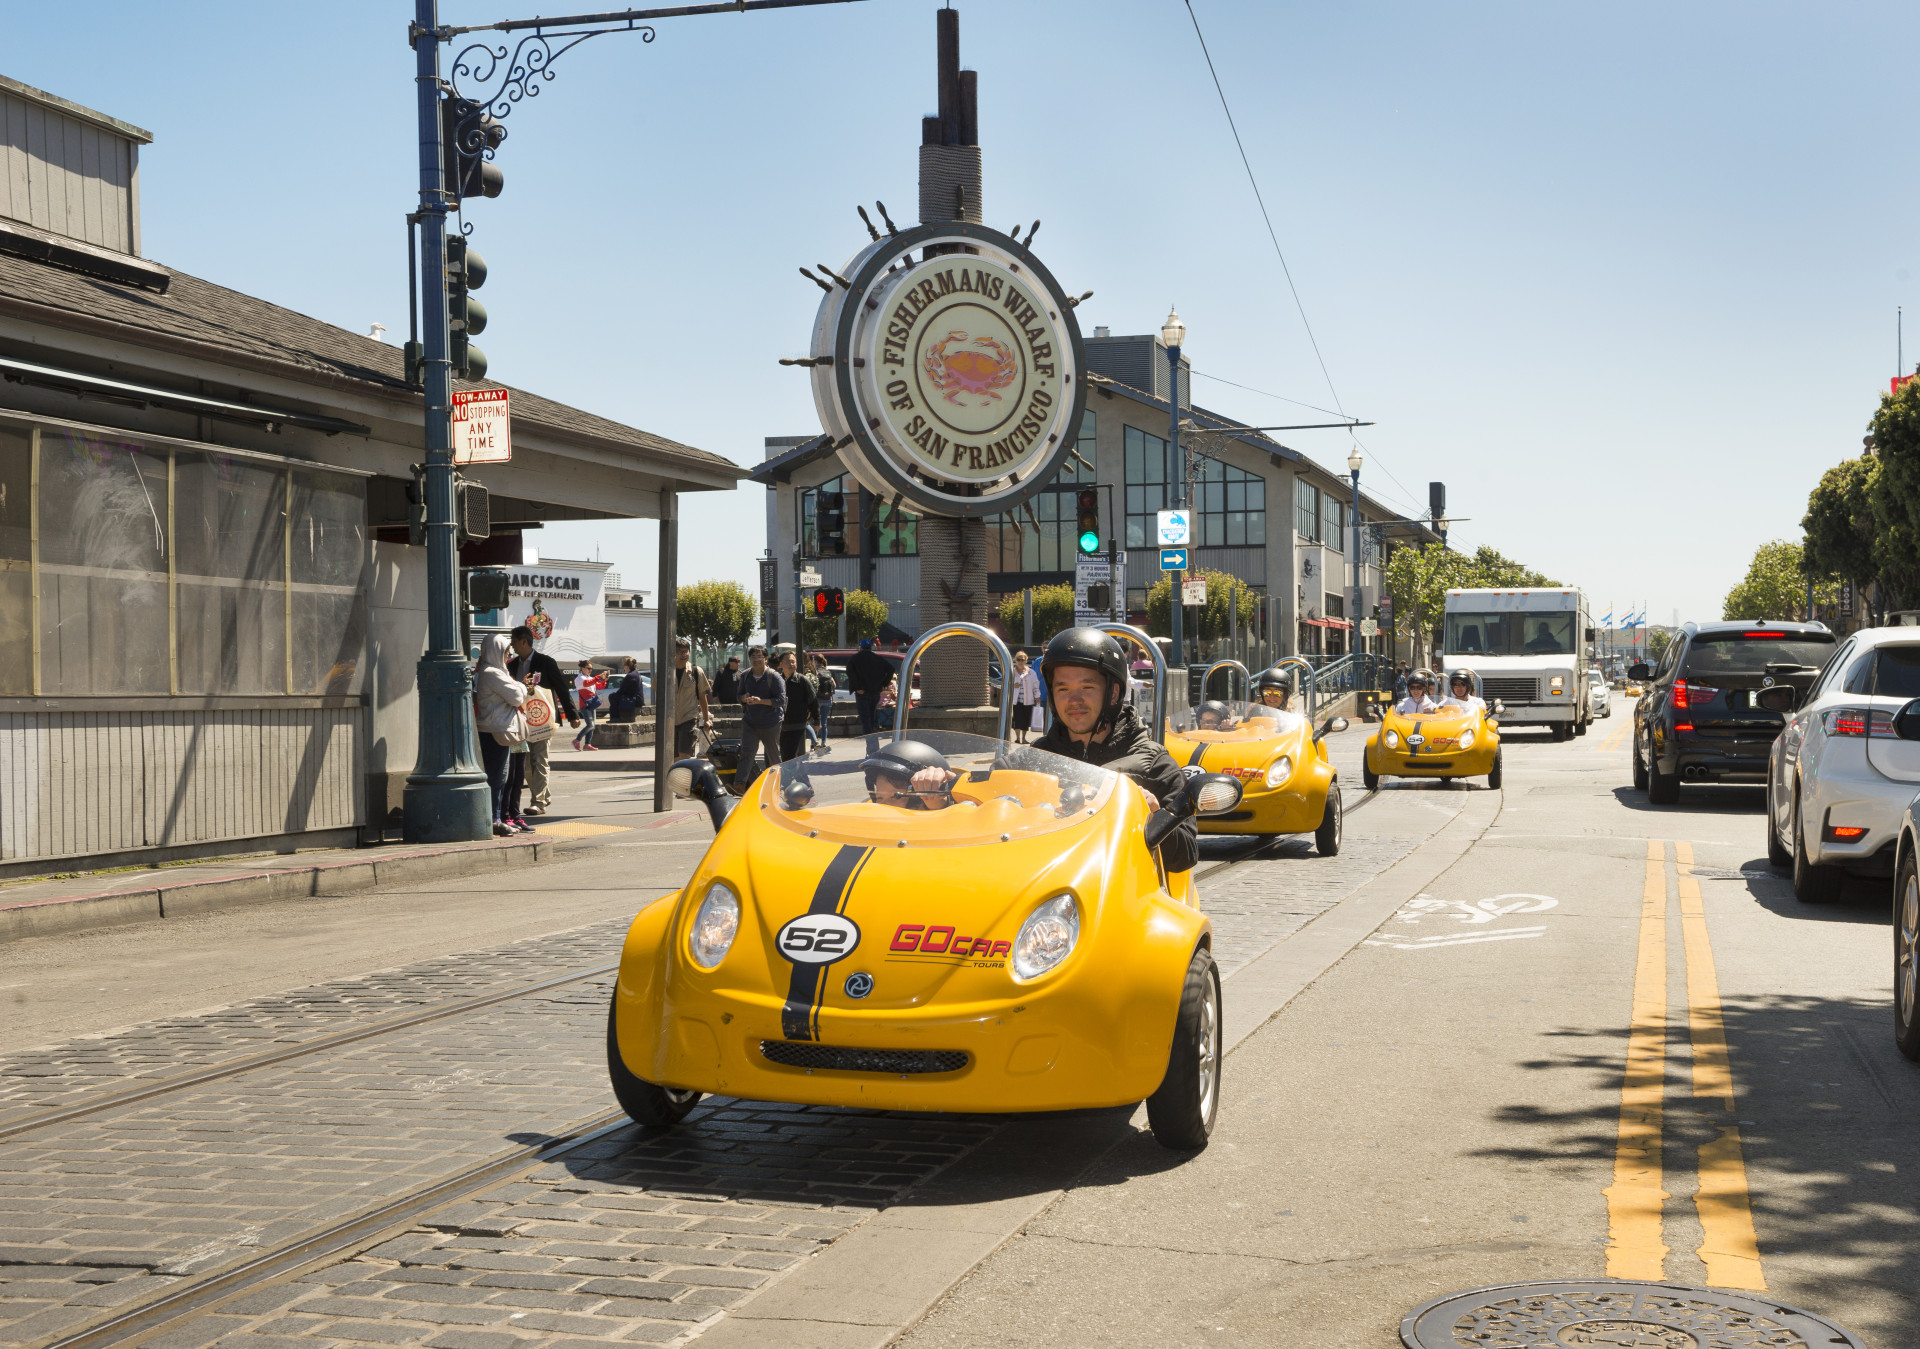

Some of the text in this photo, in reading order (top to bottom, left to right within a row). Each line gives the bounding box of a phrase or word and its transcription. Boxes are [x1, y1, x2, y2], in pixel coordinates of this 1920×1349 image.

[882, 269, 1055, 378] FISHERMANS WHARF
[455, 391, 504, 403] TOW-AWAY
[454, 403, 506, 420] NO STOPPING
[469, 422, 492, 434] ANY
[886, 380, 1054, 470] OF SAN FRANCISCO
[468, 436, 494, 449] TIME
[524, 590, 584, 600] RESTAURANT
[835, 594, 842, 610] 5
[783, 927, 850, 954] 52
